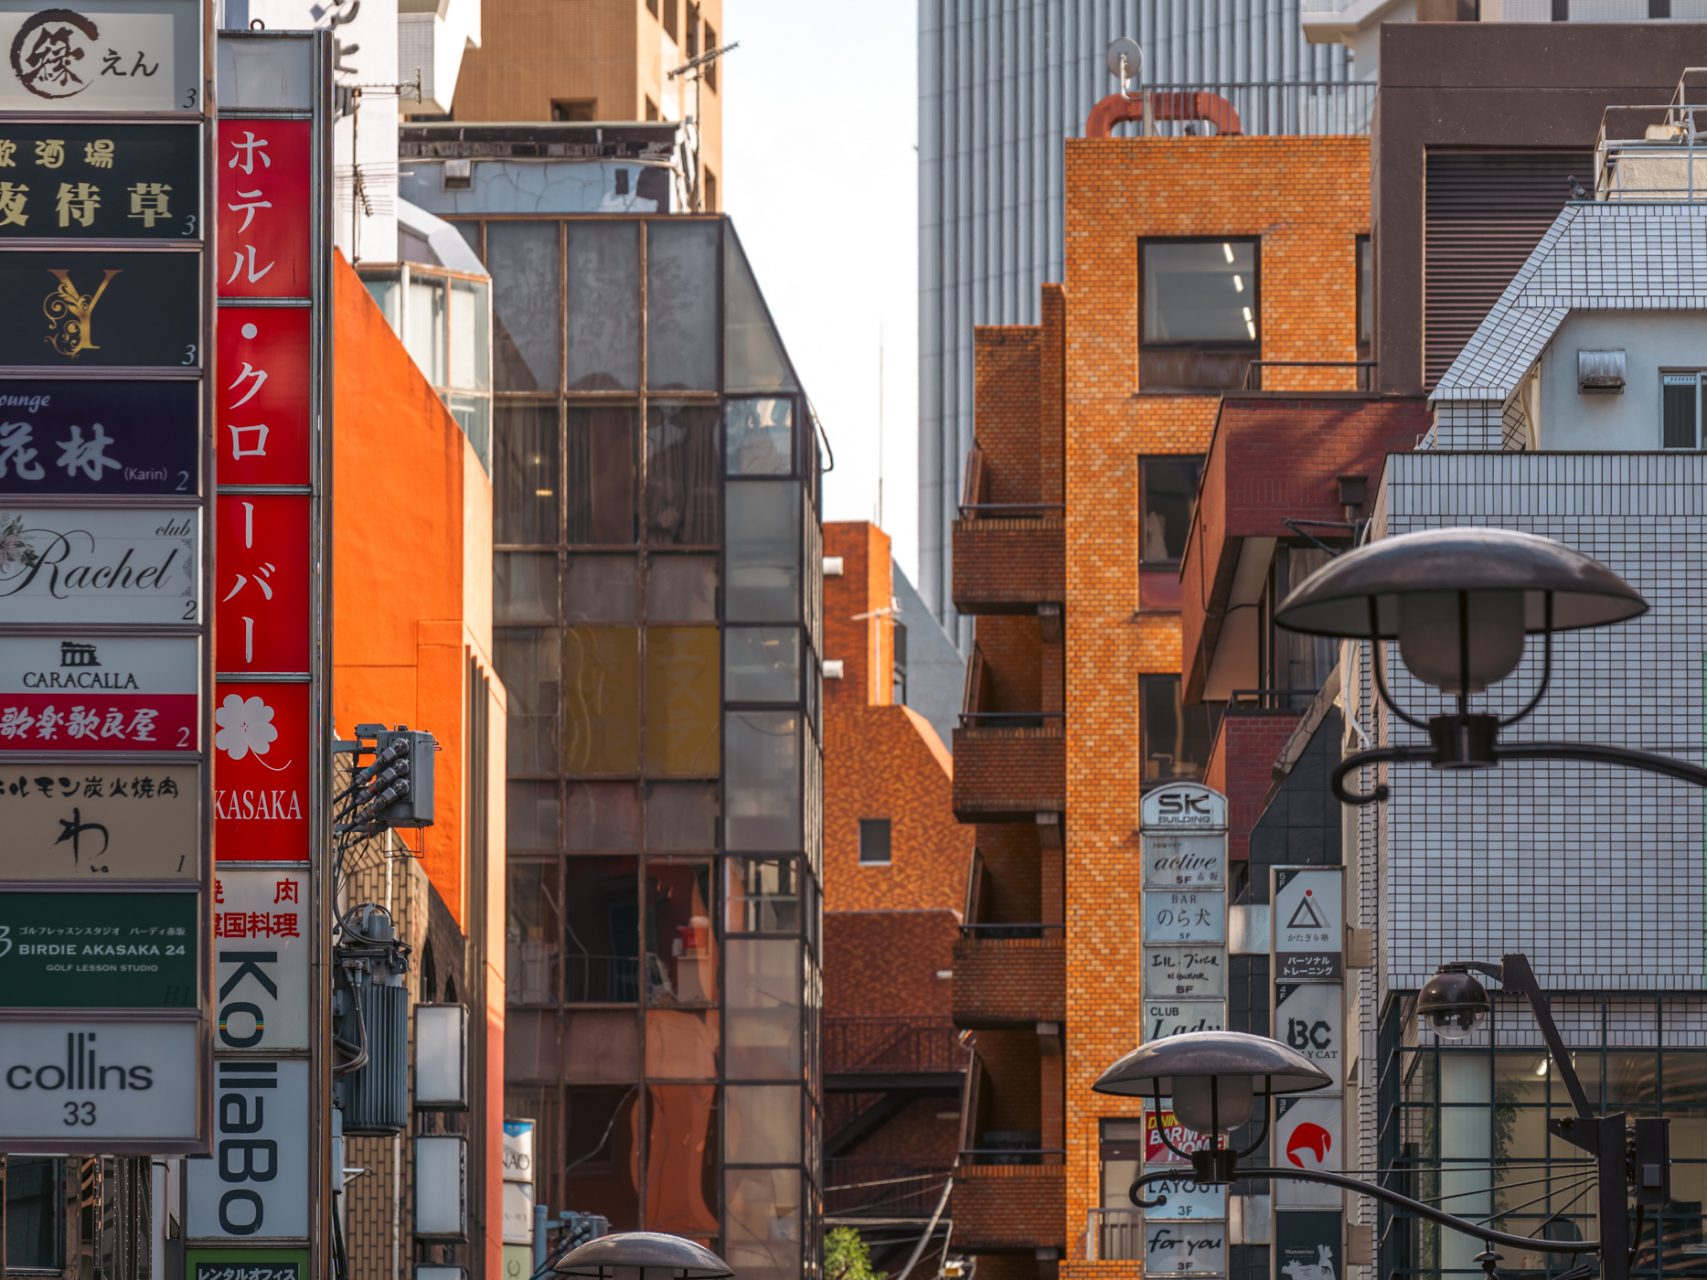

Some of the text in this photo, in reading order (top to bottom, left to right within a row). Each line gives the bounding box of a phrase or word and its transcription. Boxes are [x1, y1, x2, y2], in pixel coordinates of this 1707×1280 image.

[101, 50, 160, 77] えん
[183, 89, 196, 108] 3
[182, 215, 196, 236] 3
[182, 344, 196, 365] 3
[0, 393, 51, 413] ounge
[222, 131, 276, 664] ホテル・クローバー
[124, 466, 168, 482] (Karin)
[176, 471, 190, 491] 2
[155, 518, 191, 537] club
[0, 528, 179, 600] Rachel
[182, 601, 197, 621] 2
[22, 671, 140, 690] CARACALLA
[176, 727, 191, 747] 2
[214, 789, 302, 820] KASAKA
[1158, 793, 1211, 814] SK
[1158, 815, 1211, 823] BUILDING
[176, 854, 186, 873] 1
[1153, 853, 1217, 871] active
[1176, 876, 1192, 884] 5F
[274, 878, 299, 904] 肉
[1171, 895, 1197, 904] BAR
[1157, 908, 1211, 927] のら犬
[18, 944, 186, 956] BIRDIE AKASAKA 24
[46, 964, 159, 973] GOLF LESSON STUDIO
[1287, 956, 1330, 966] パーソナル
[1283, 966, 1334, 977] トレーニング
[1176, 985, 1194, 994] 5F
[1150, 1006, 1179, 1016] CLUB
[6, 1032, 154, 1091] collins
[63, 1101, 97, 1127] 33
[1177, 1205, 1193, 1216] 3F
[1148, 1229, 1221, 1257] for you
[1177, 1262, 1193, 1271] 3F
